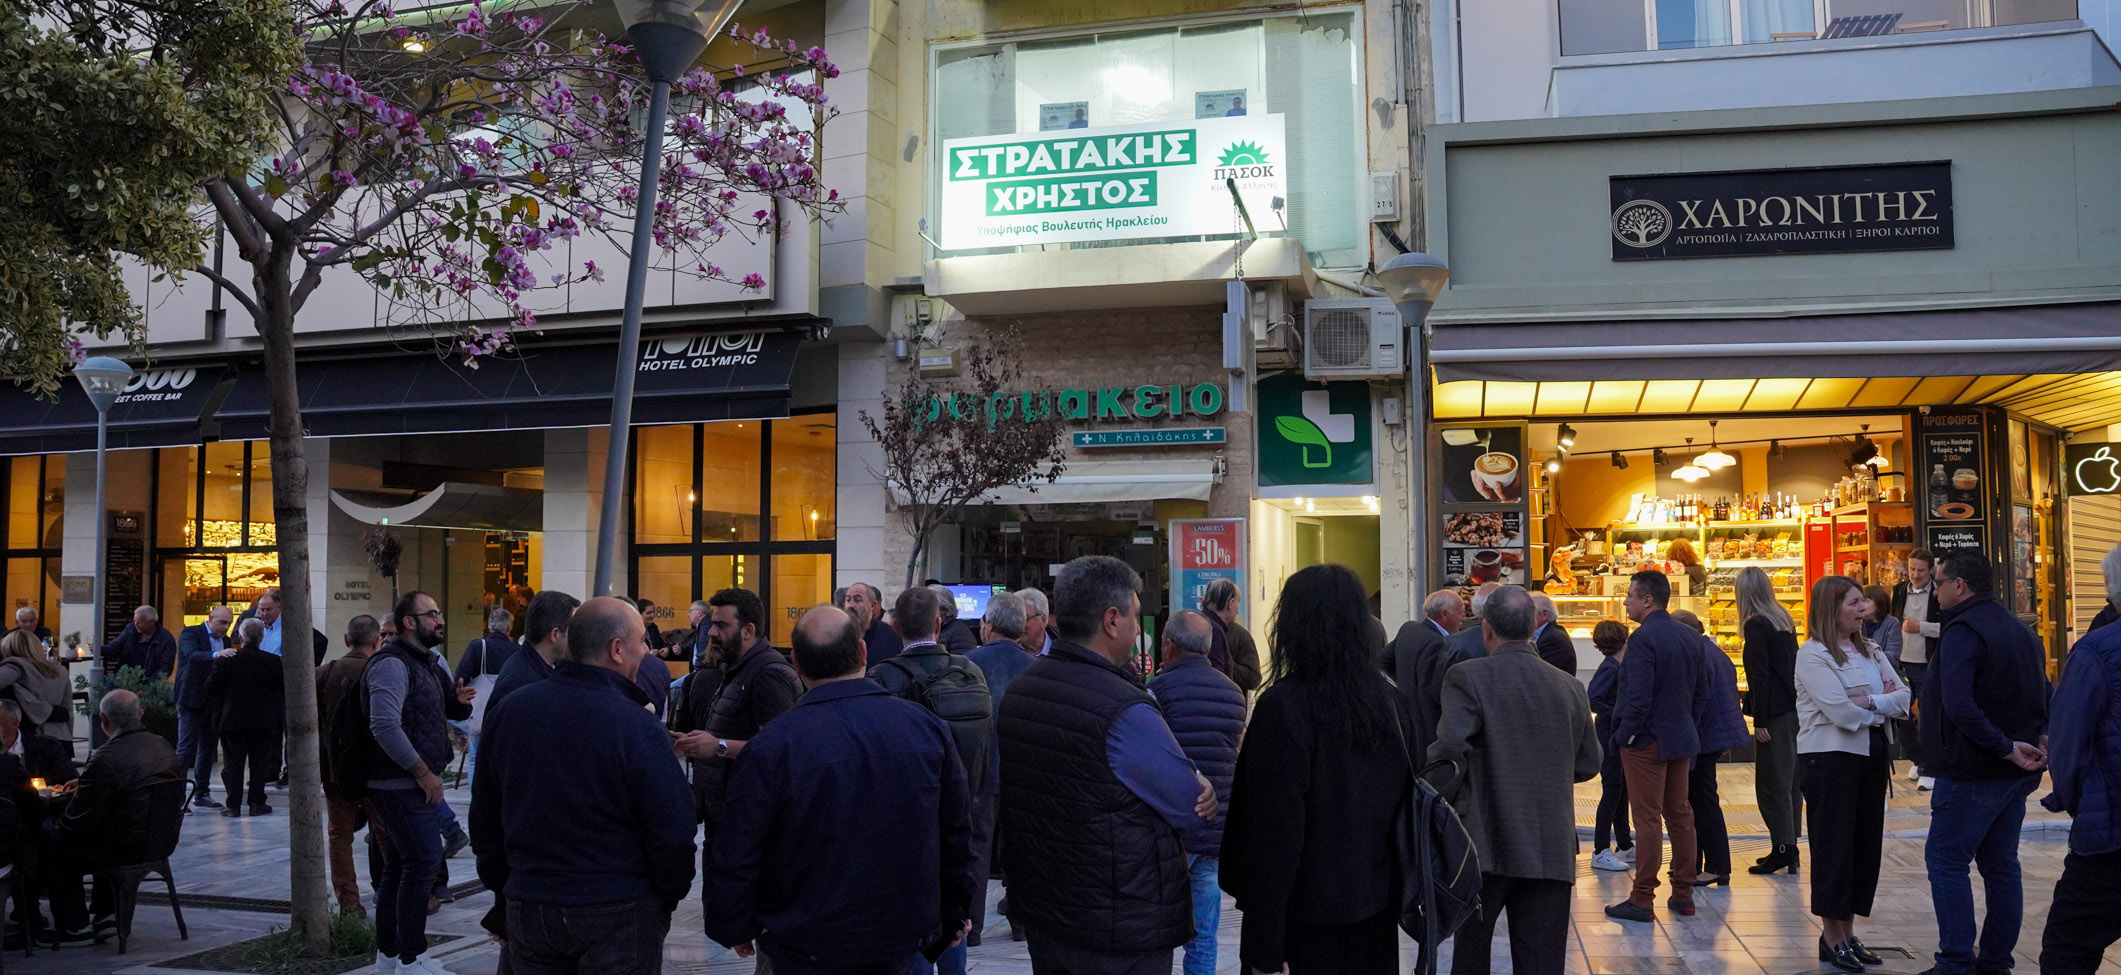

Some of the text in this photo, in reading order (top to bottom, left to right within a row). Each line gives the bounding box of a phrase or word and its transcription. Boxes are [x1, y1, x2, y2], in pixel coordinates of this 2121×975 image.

[955, 132, 1190, 178] ΣΤΡΑΤΑΚΗΣ
[1214, 165, 1275, 180] ΠΑΣΟΚ
[992, 177, 1150, 212] ΧΡΗΣΤΟΣ
[1676, 189, 1938, 230] ΧΑΡΩΝΙΤΗΣ
[1042, 219, 1103, 232] Βουλευτής
[1106, 214, 1168, 231] Ηρακλείου
[1746, 230, 1846, 243] ΖΑΧΑΡΟΠΛΑΣΤΙΚΗ
[1855, 228, 1891, 239] ΞΗΡΟΙ
[1894, 225, 1940, 237] ΚΑΡΠΟΙ
[639, 354, 758, 371] HOTEL OLYMPIC
[132, 393, 163, 402] COFFEE
[164, 392, 182, 400] BAR
[1922, 414, 1979, 426] ΠΡΟΣΦΟΡΕΣ
[334, 592, 371, 601] OLYMPIC
